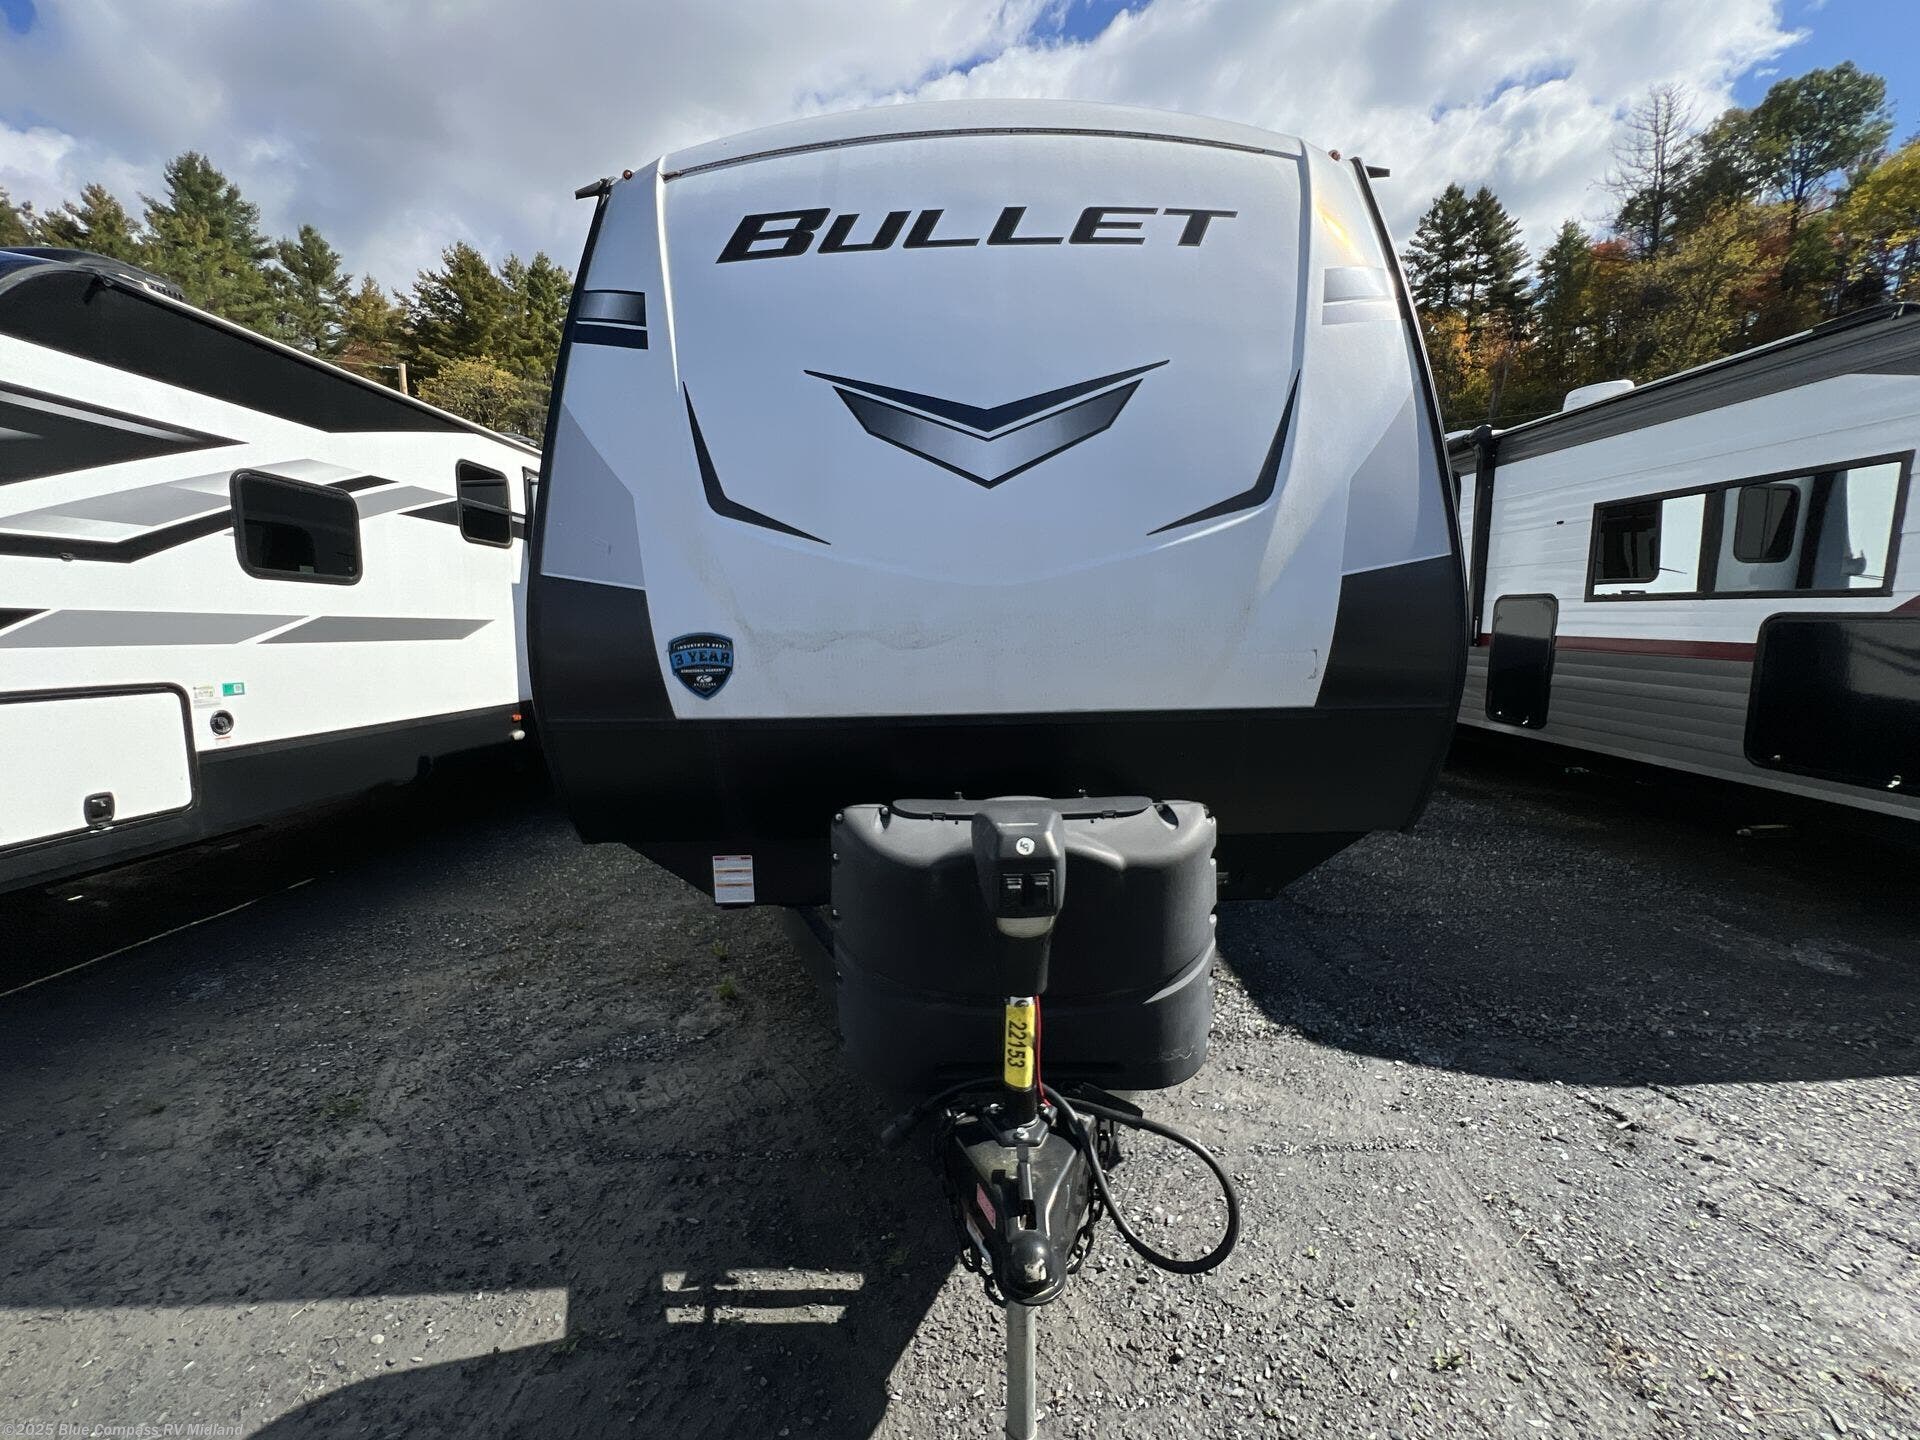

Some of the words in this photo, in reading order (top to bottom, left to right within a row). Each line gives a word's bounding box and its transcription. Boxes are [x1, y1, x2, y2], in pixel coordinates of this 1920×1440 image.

[715, 207, 1238, 264] BULLET
[674, 654, 684, 666] 3
[687, 650, 730, 664] YEAR
[1007, 1020, 1027, 1068] 22153
